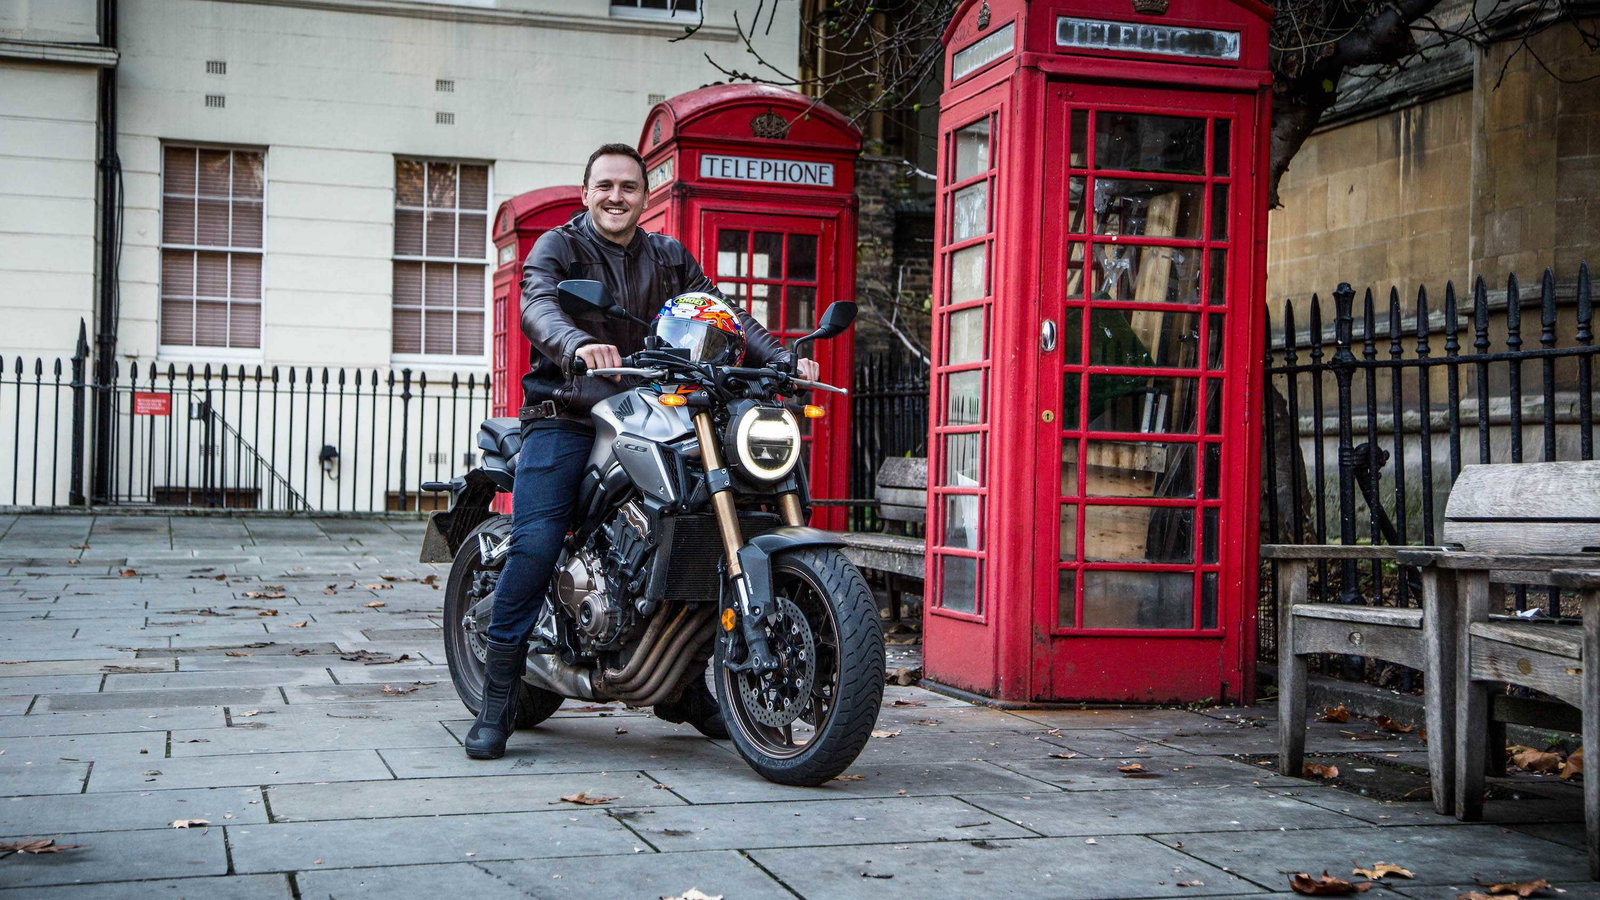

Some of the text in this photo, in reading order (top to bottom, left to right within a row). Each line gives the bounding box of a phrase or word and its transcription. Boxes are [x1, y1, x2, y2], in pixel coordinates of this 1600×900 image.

[1066, 20, 1237, 57] TELEPH
[705, 156, 831, 185] TELEPHONE
[677, 297, 704, 306] SHOEI
[624, 443, 647, 453] CB
